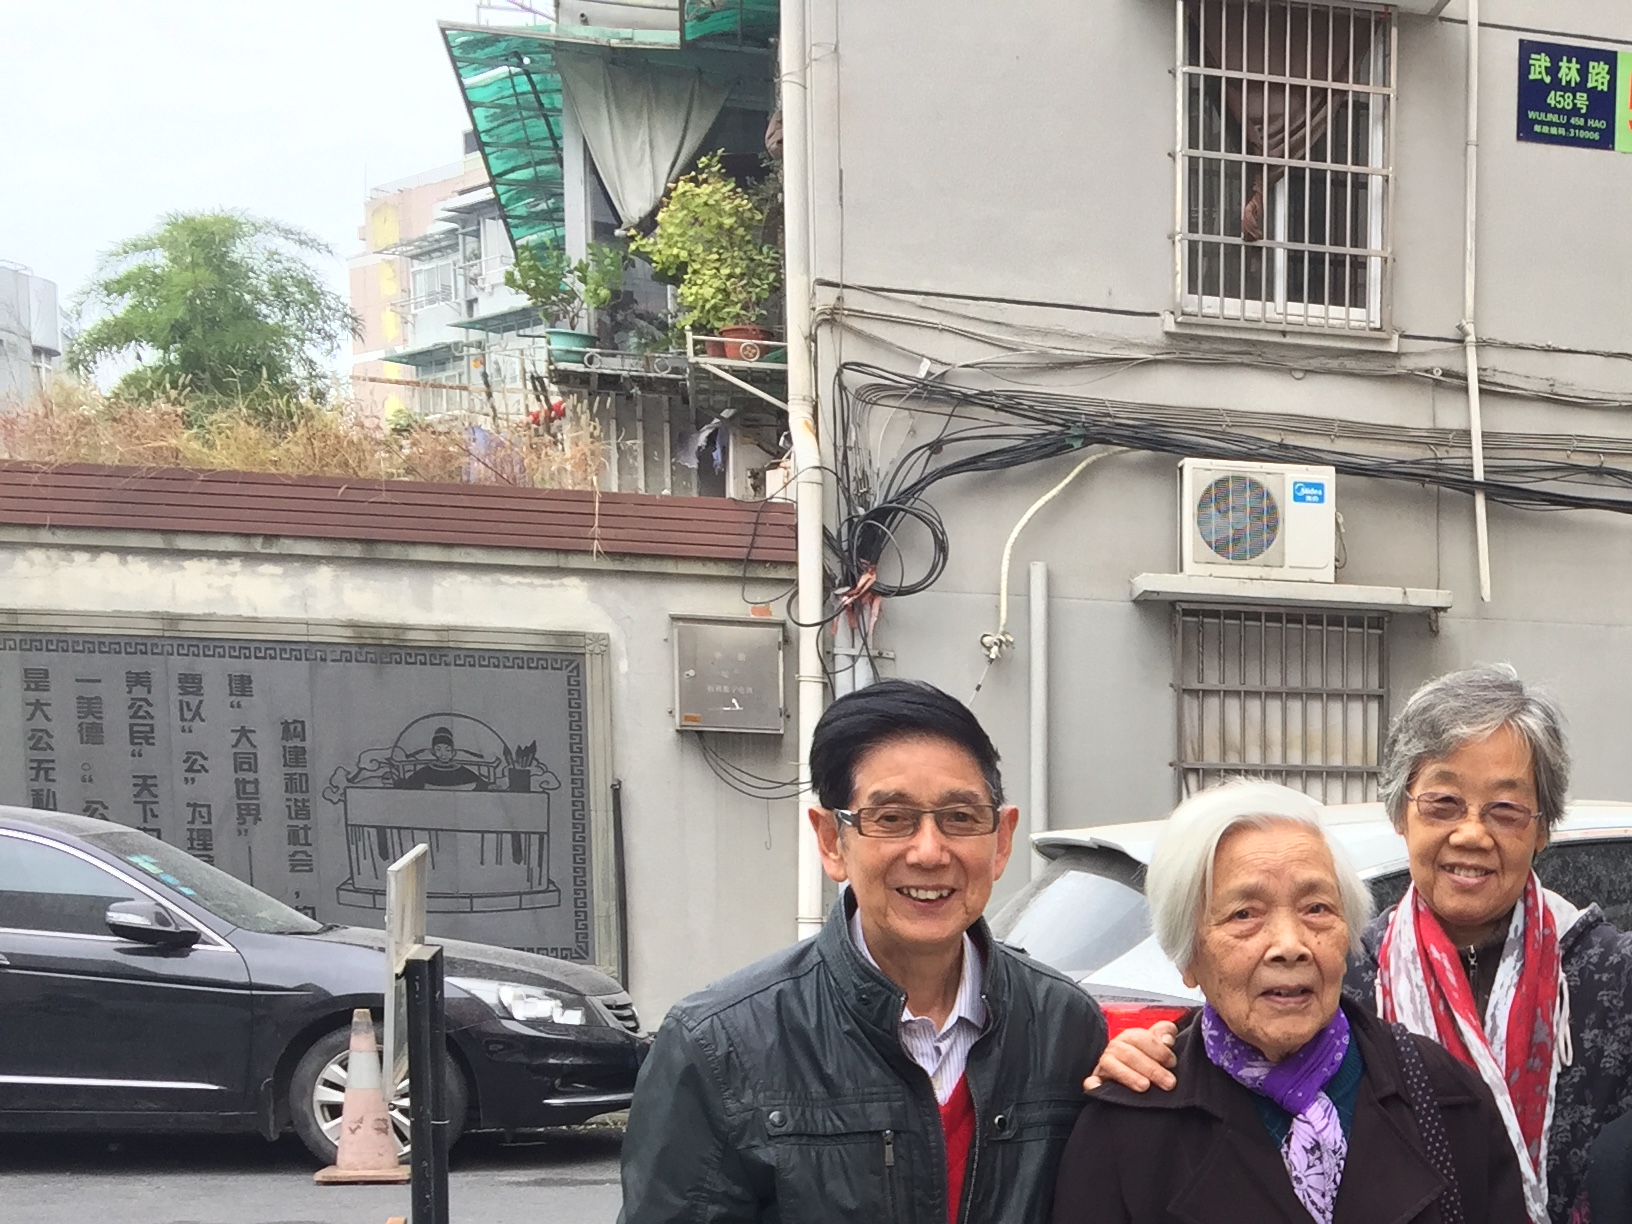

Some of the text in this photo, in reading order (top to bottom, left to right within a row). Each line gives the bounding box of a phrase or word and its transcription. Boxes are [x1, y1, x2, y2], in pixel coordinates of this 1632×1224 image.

[1528, 53, 1610, 91] 武林路
[1547, 90, 1589, 114] 458号
[1528, 110, 1607, 129] WULINLU 458 HAO
